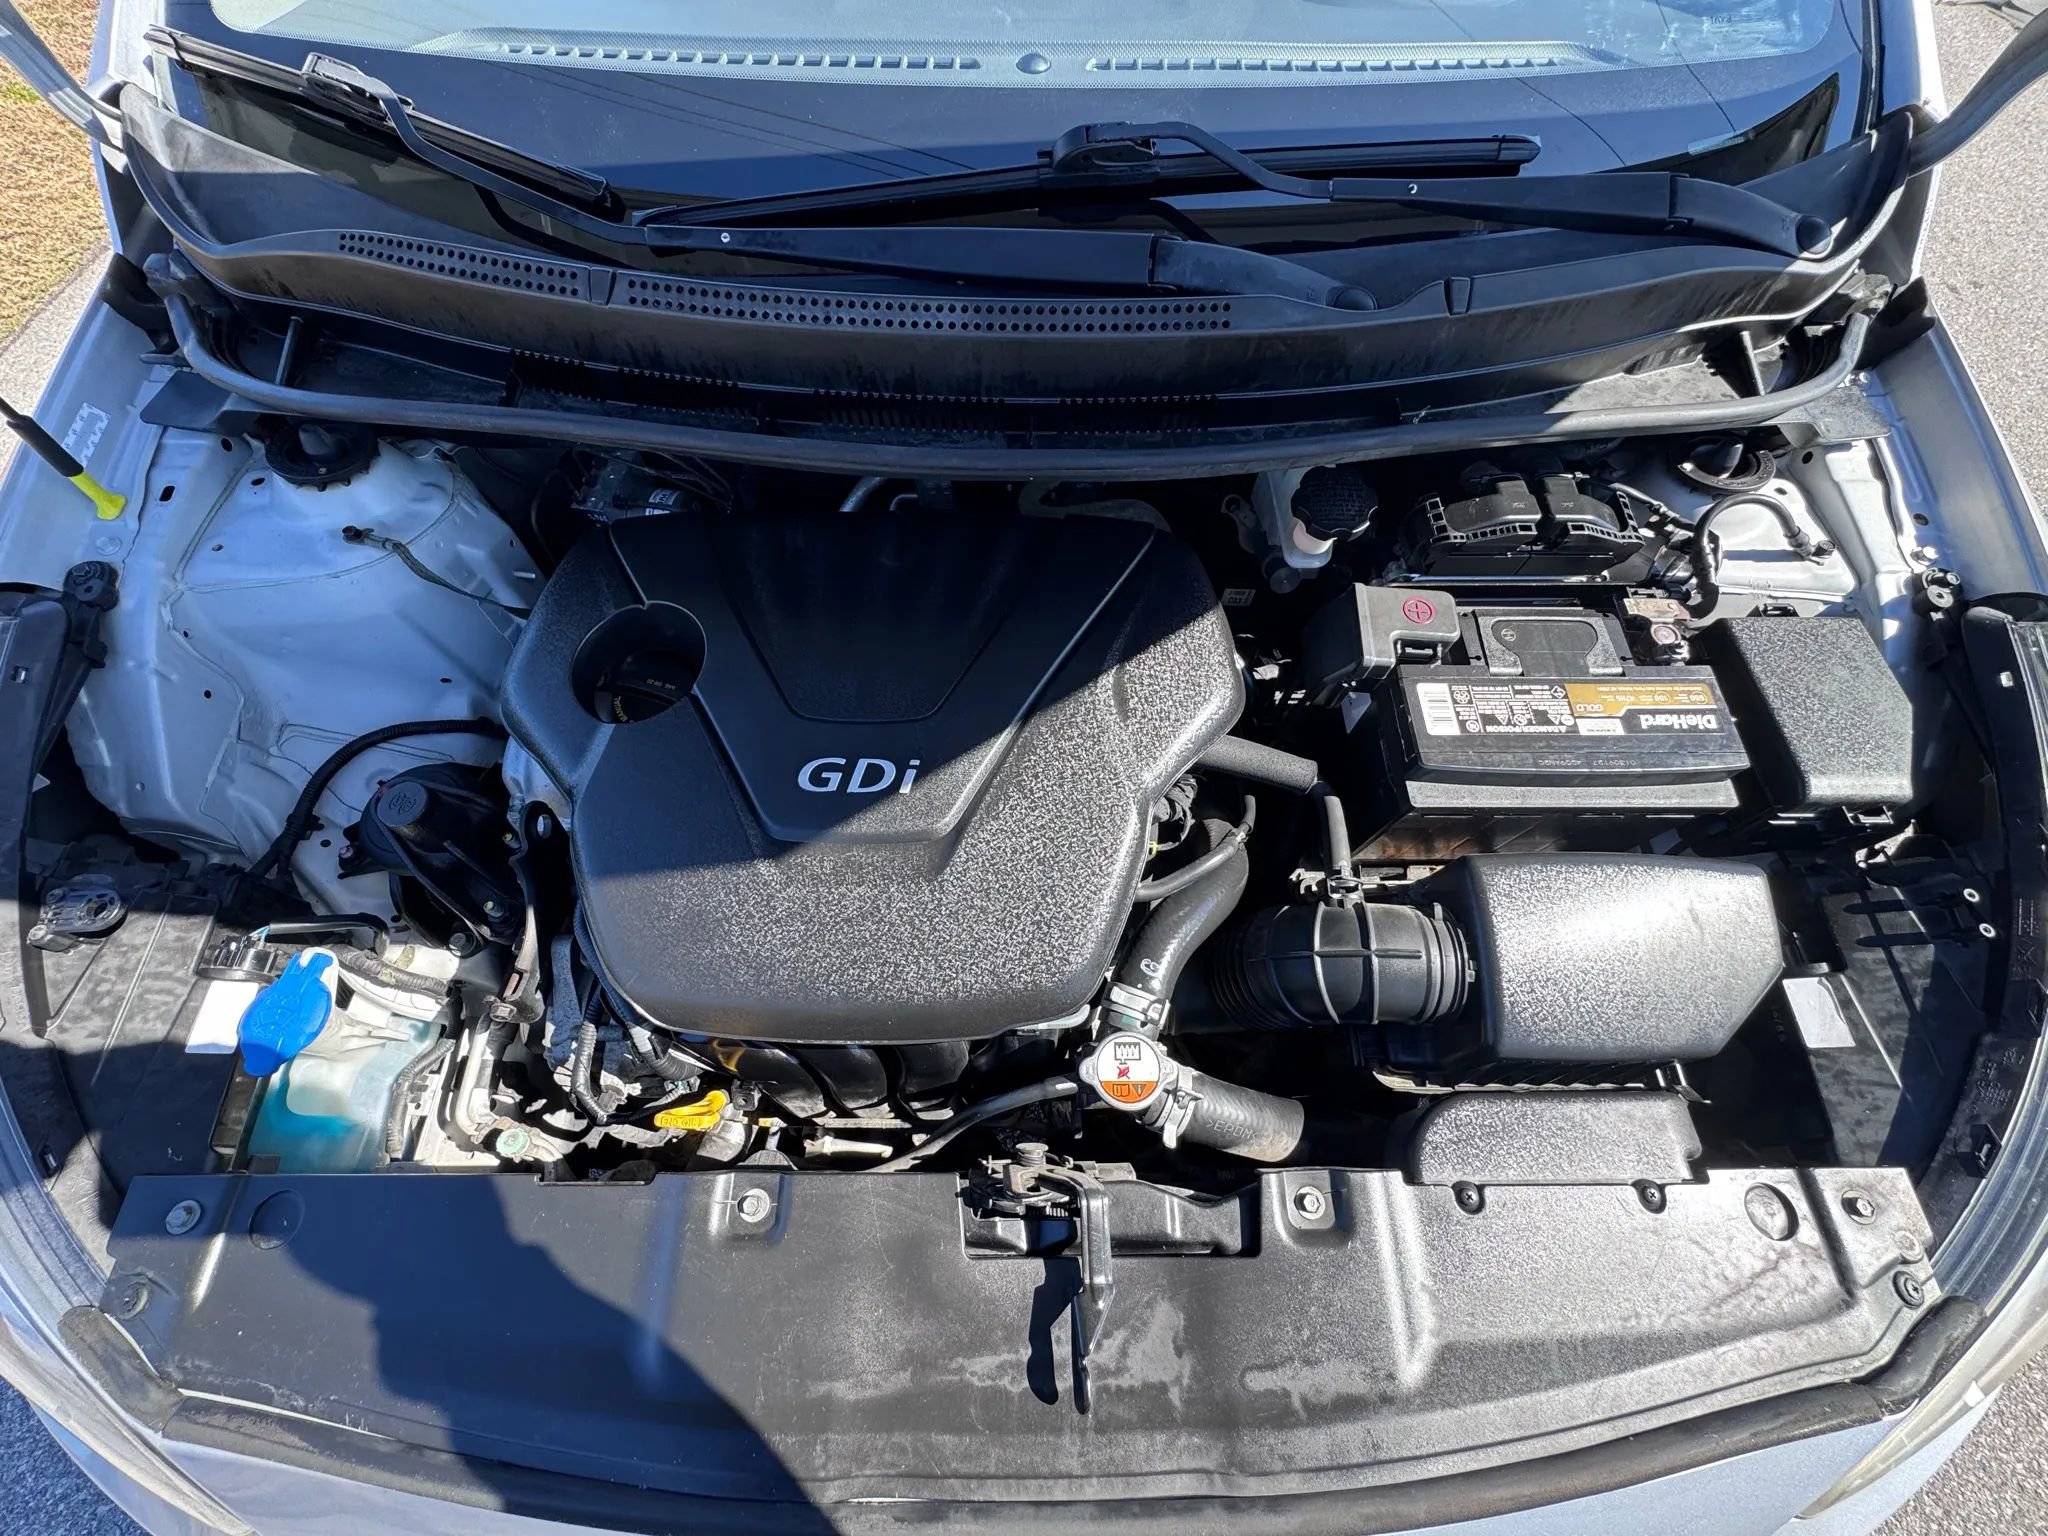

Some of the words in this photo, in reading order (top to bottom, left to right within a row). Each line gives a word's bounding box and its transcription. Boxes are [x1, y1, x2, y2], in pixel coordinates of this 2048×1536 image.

[1576, 703, 1603, 711] GOLD
[1639, 714, 1718, 729] DieHard
[797, 757, 921, 794] GDi
